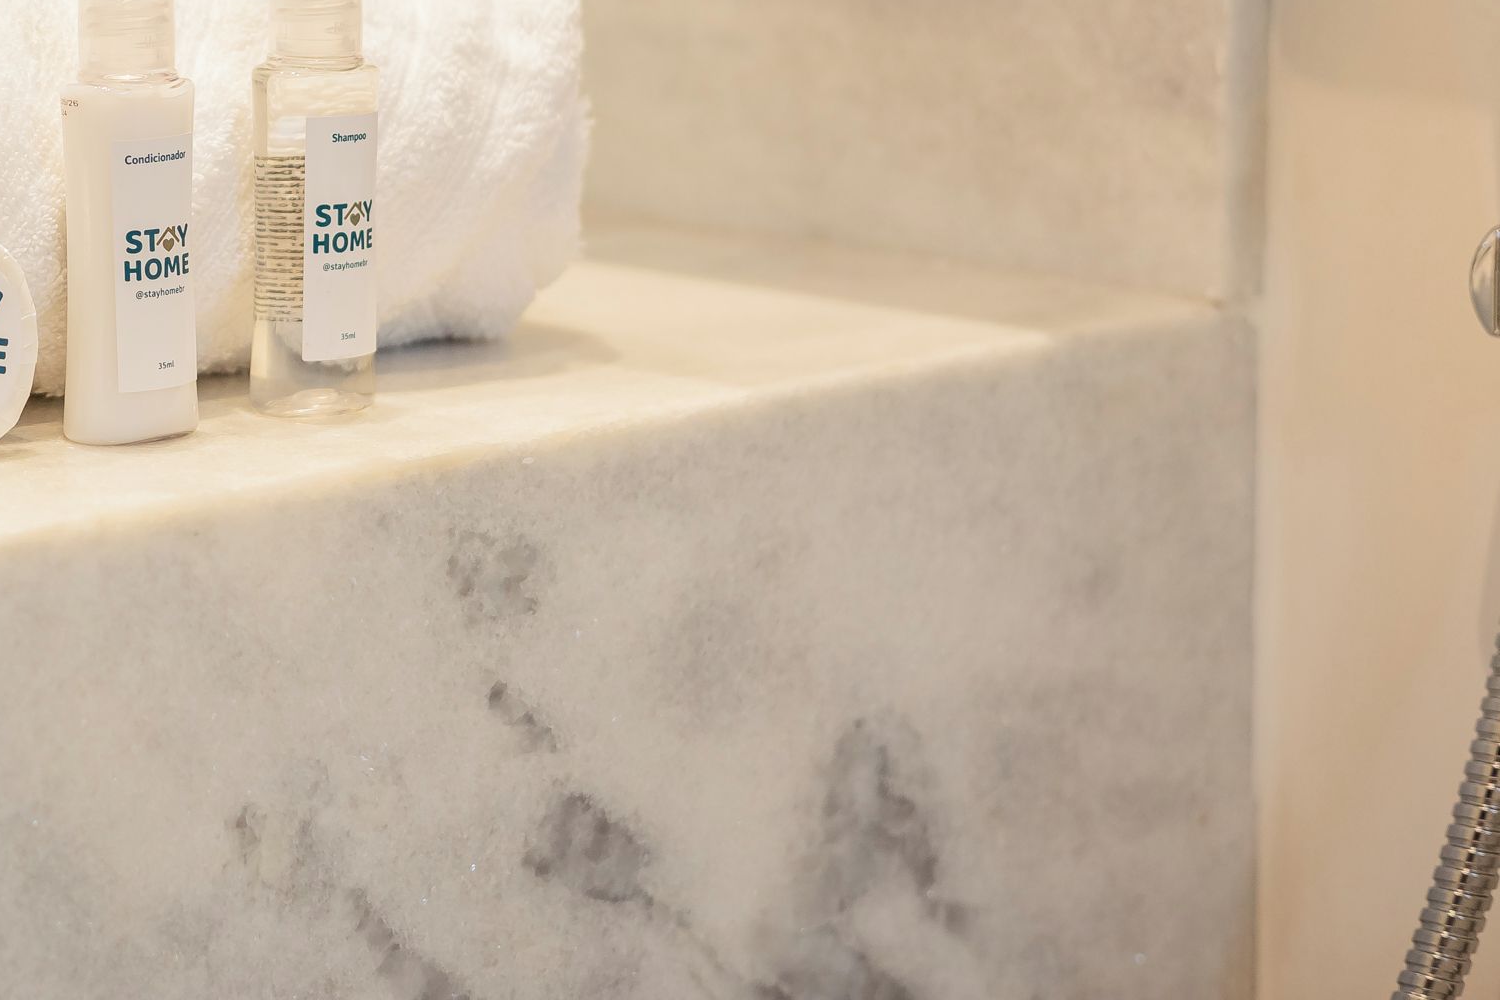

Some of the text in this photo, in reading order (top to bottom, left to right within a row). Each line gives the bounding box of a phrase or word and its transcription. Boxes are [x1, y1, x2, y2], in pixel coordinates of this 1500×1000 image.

[331, 132, 367, 143] Shampoo
[124, 150, 186, 165] Condicionador
[125, 223, 188, 254] STAY
[312, 227, 373, 254] HOME
[124, 252, 190, 282] HOME
[323, 259, 368, 271] @stayhomebr
[135, 285, 185, 300] @stayhomebr
[340, 331, 356, 341] 35ml
[158, 360, 175, 370] 35ml
